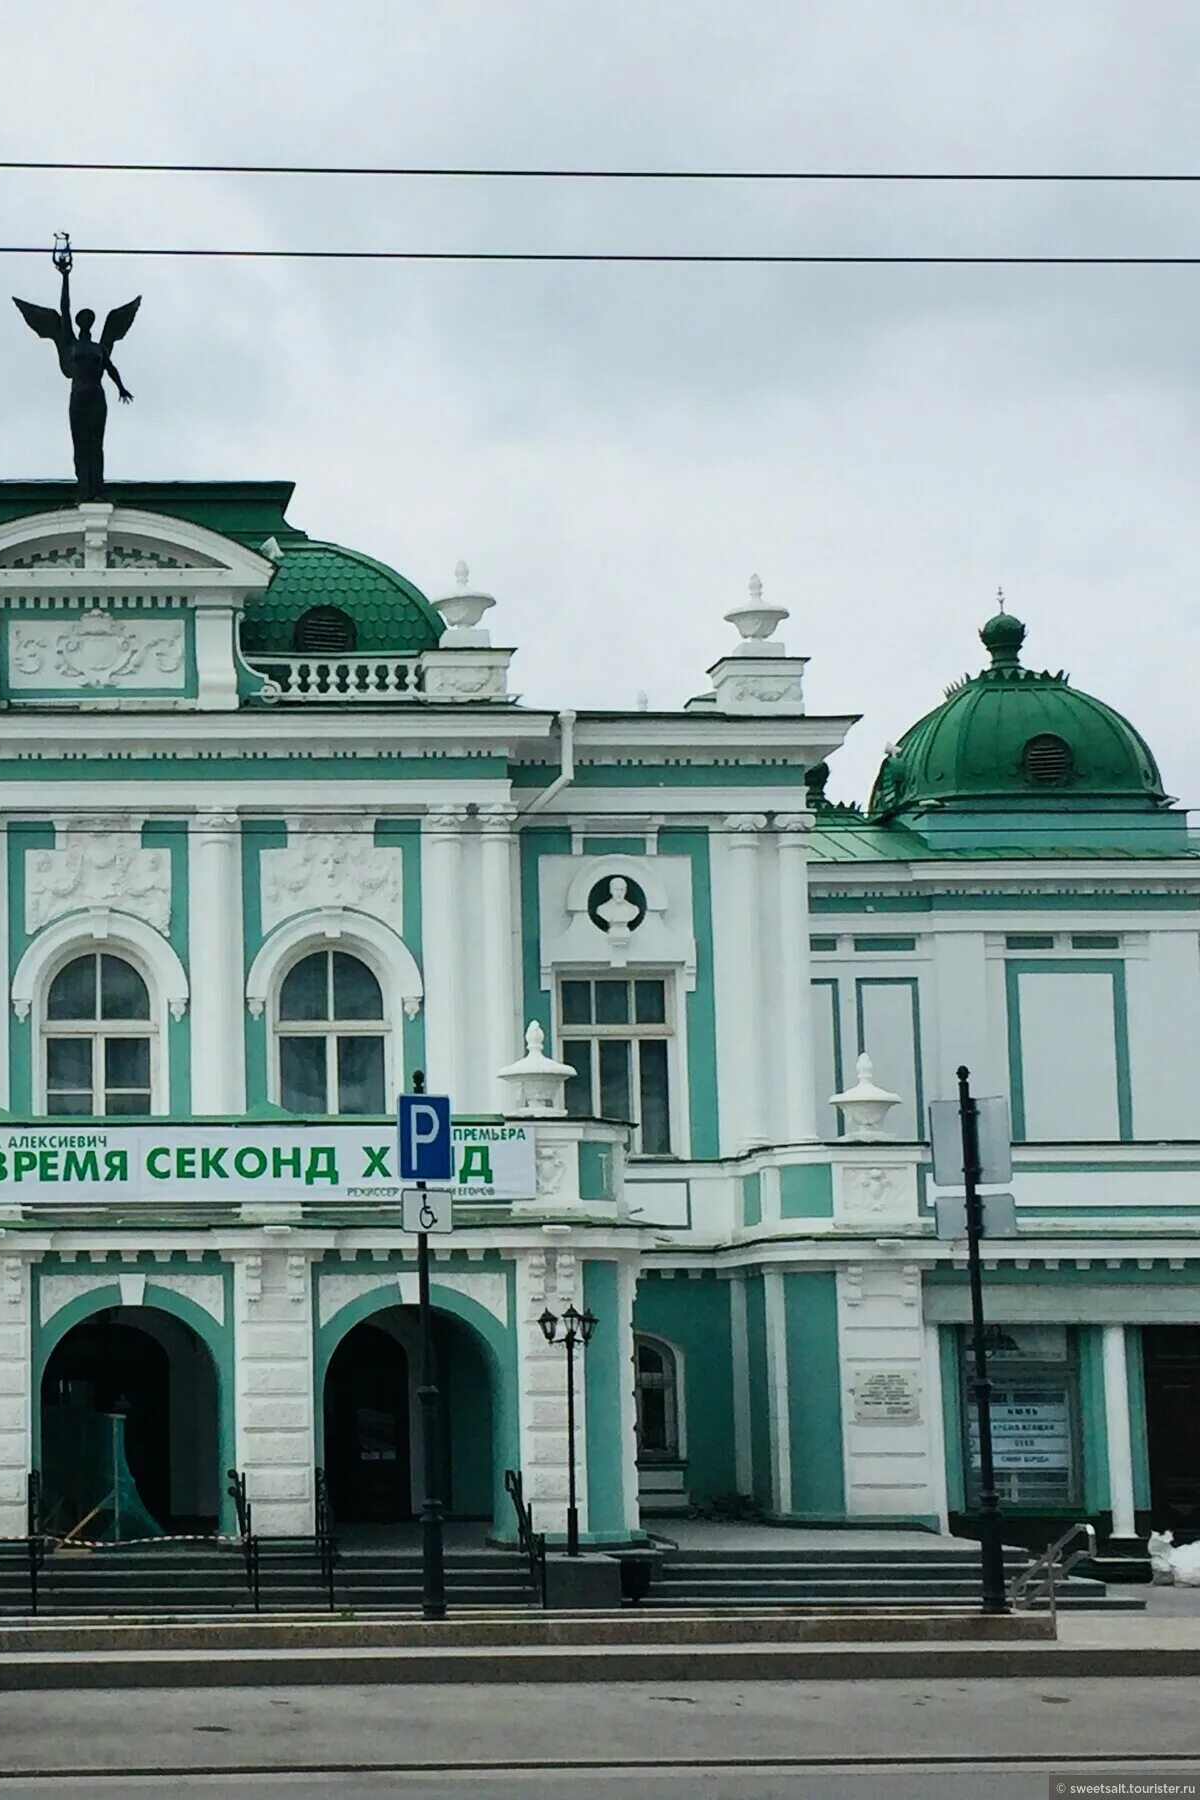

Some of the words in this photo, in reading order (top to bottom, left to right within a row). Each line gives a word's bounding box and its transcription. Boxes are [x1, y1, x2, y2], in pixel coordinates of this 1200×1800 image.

[7, 1135, 108, 1149] АЛЕКСИЕВИЧ
[411, 1104, 440, 1170] P
[453, 1127, 526, 1142] ПРЕМЬЕРА
[146, 1146, 339, 1184] СЕКОНД
